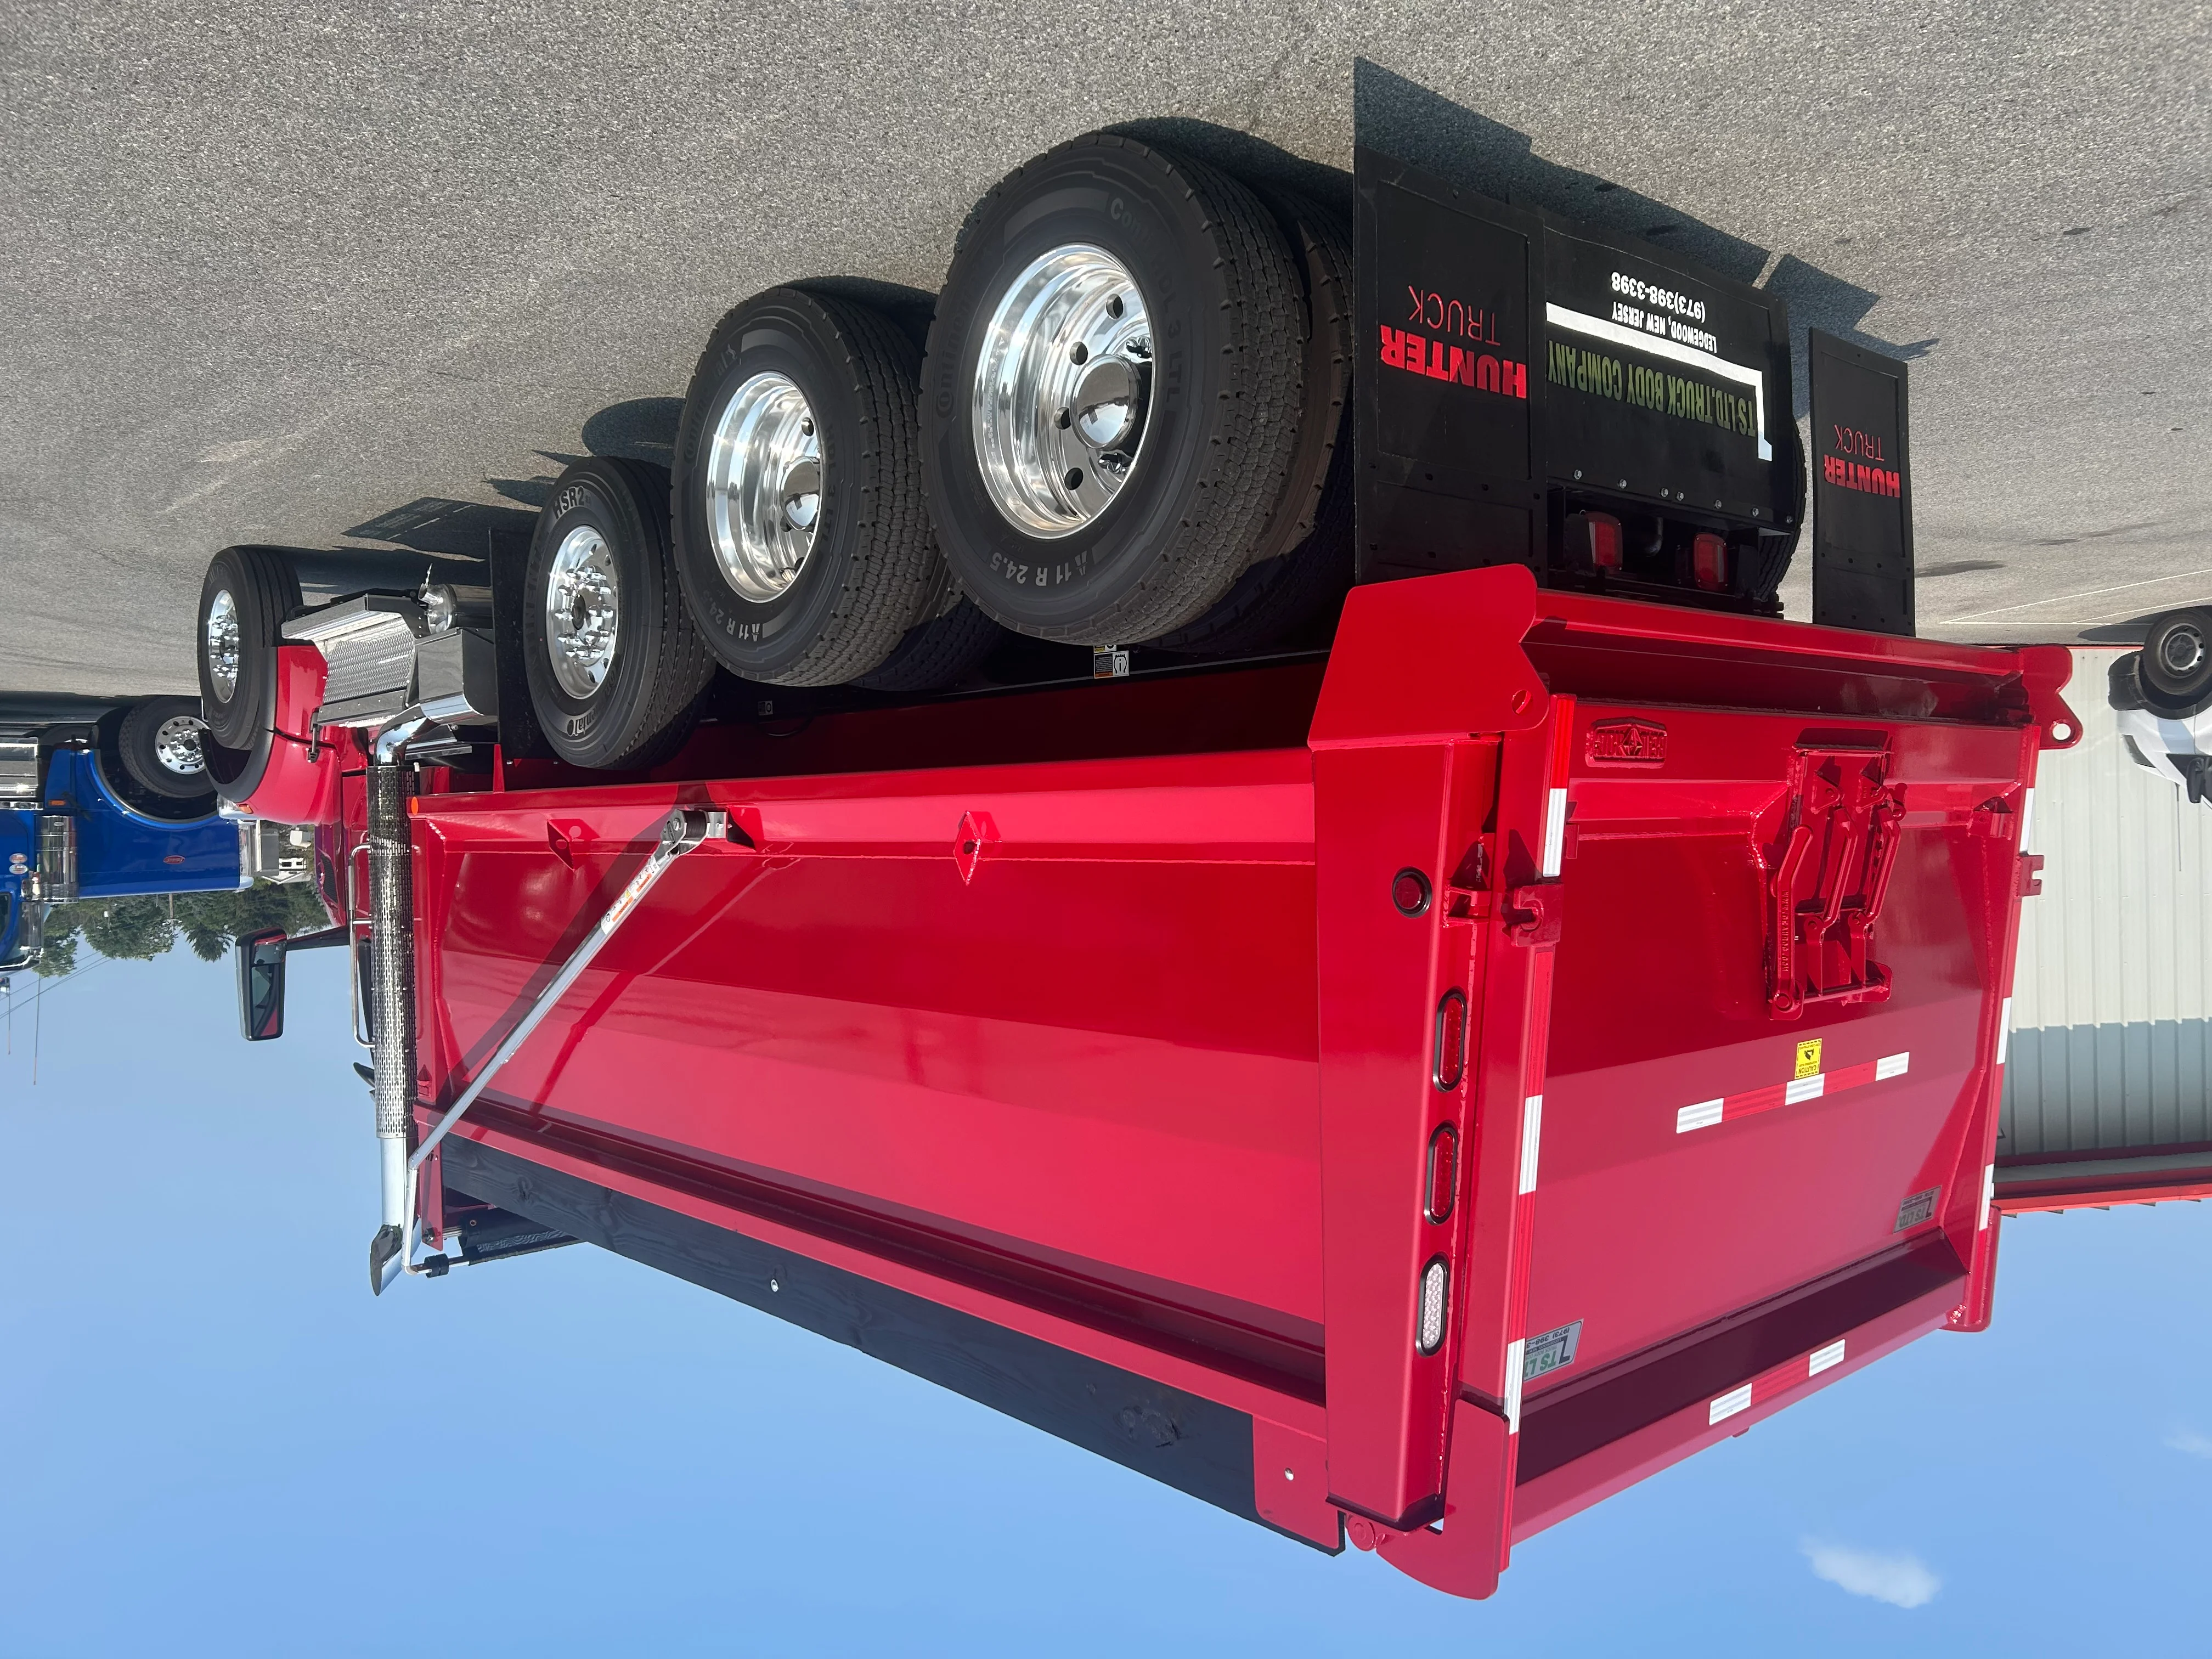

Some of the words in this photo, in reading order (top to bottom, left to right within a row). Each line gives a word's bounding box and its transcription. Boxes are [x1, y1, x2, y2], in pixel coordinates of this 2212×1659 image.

[1611, 272, 1706, 323] (973)398-3398
[1408, 285, 1500, 346] TRUCK
[1611, 301, 1645, 328] JERSEY
[1646, 313, 1666, 335] NEW
[1668, 316, 1717, 354] LEDGEWOOD,
[1380, 324, 1527, 399] HUNTER
[1547, 340, 1622, 400] COMPANY
[1626, 364, 1663, 411] BODY
[1738, 398, 1756, 437] TS
[1834, 424, 1884, 461] TRUCK
[1824, 454, 1900, 498] HUNTER
[551, 487, 585, 520] HSR2
[990, 552, 1029, 584] 24.5
[1035, 567, 1048, 586] R
[1056, 562, 1072, 584] 11
[726, 617, 736, 635] R
[738, 623, 749, 640] 11
[1798, 1065, 1816, 1074] CAUTION
[1540, 1350, 1557, 1371] TS
